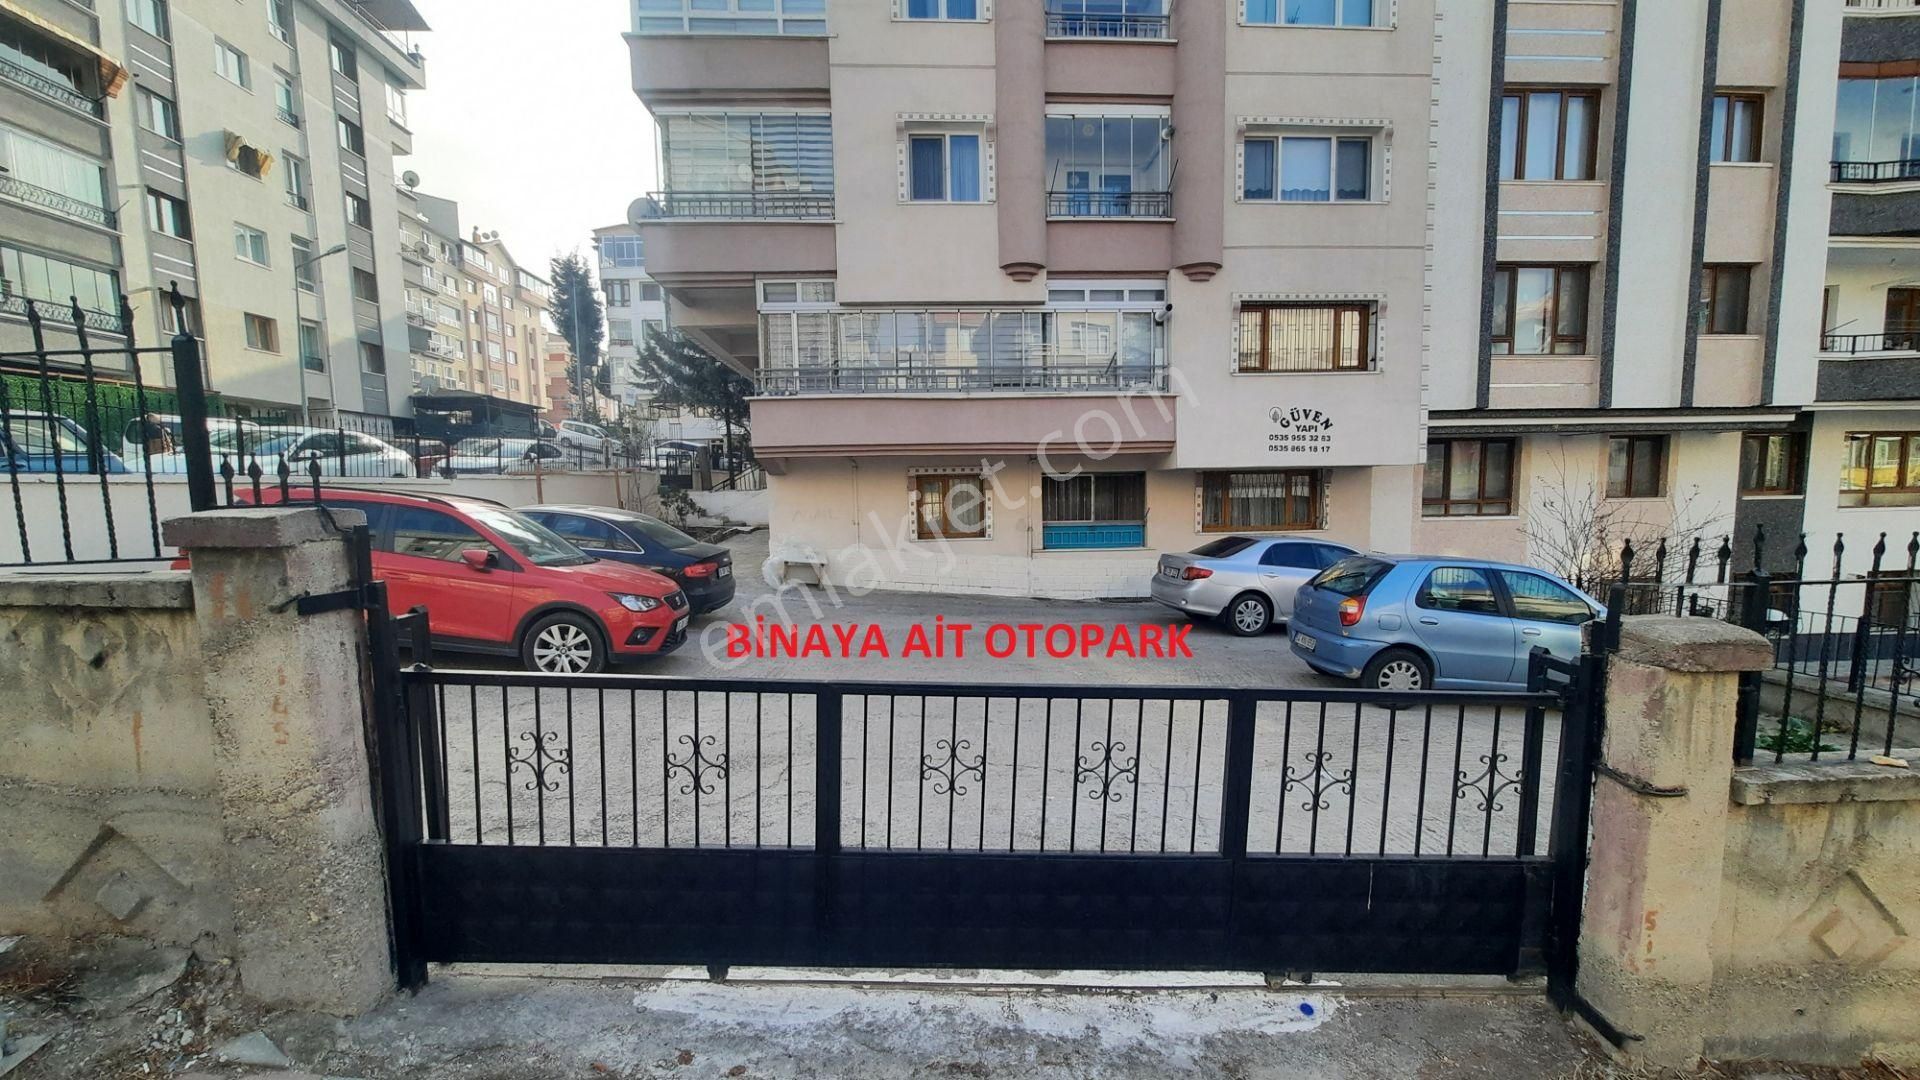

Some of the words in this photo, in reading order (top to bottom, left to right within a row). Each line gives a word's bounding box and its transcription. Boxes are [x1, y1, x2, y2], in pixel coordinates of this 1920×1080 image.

[1280, 407, 1333, 430] GÜVEN
[1291, 434, 1306, 442] 955
[1308, 434, 1319, 442] 32
